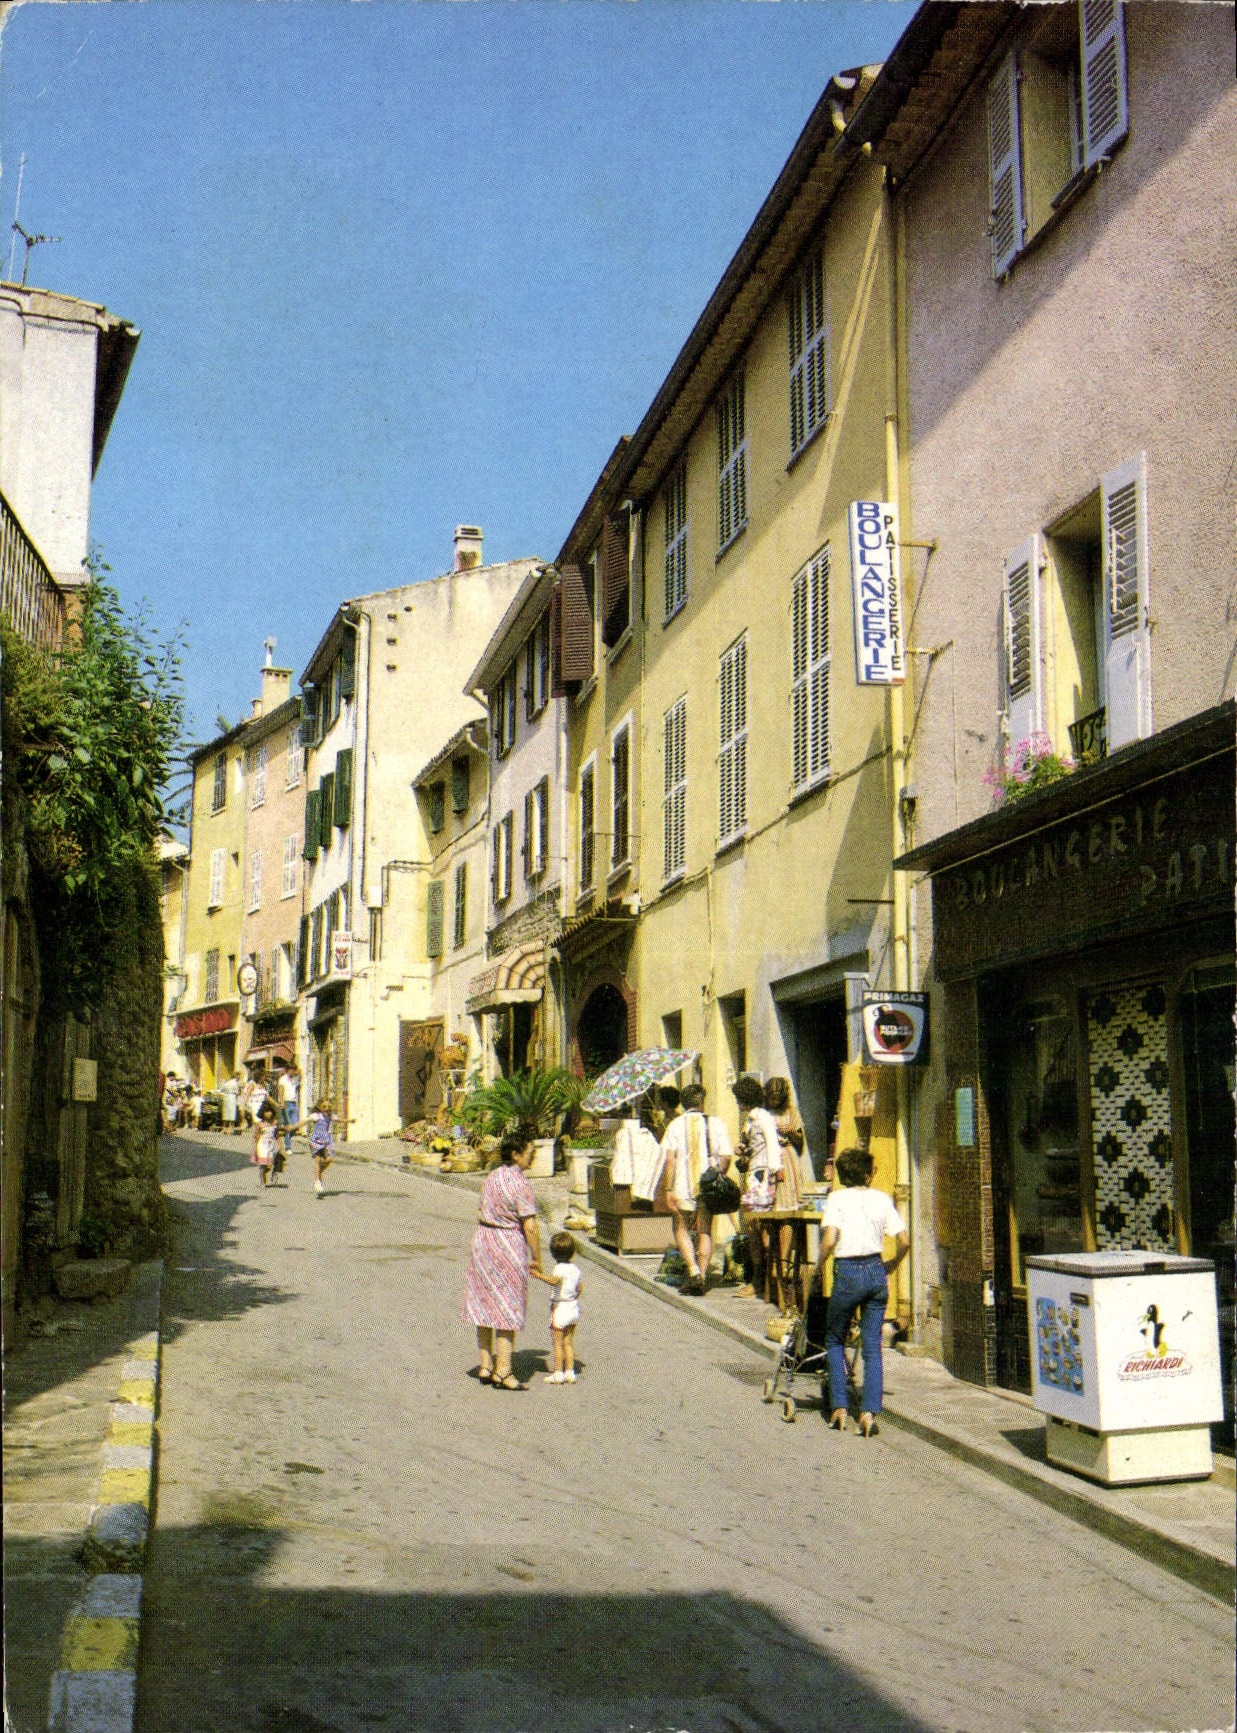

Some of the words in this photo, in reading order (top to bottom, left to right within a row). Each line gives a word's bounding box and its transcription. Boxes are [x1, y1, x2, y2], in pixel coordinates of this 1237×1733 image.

[857, 502, 889, 682] BOULANGERIE
[883, 515, 901, 671] PATISSERIE
[954, 797, 1169, 910] BOULANGERIE
[863, 991, 925, 1002] PRIMAGAZ
[1123, 1356, 1185, 1374] RICHIARDI
